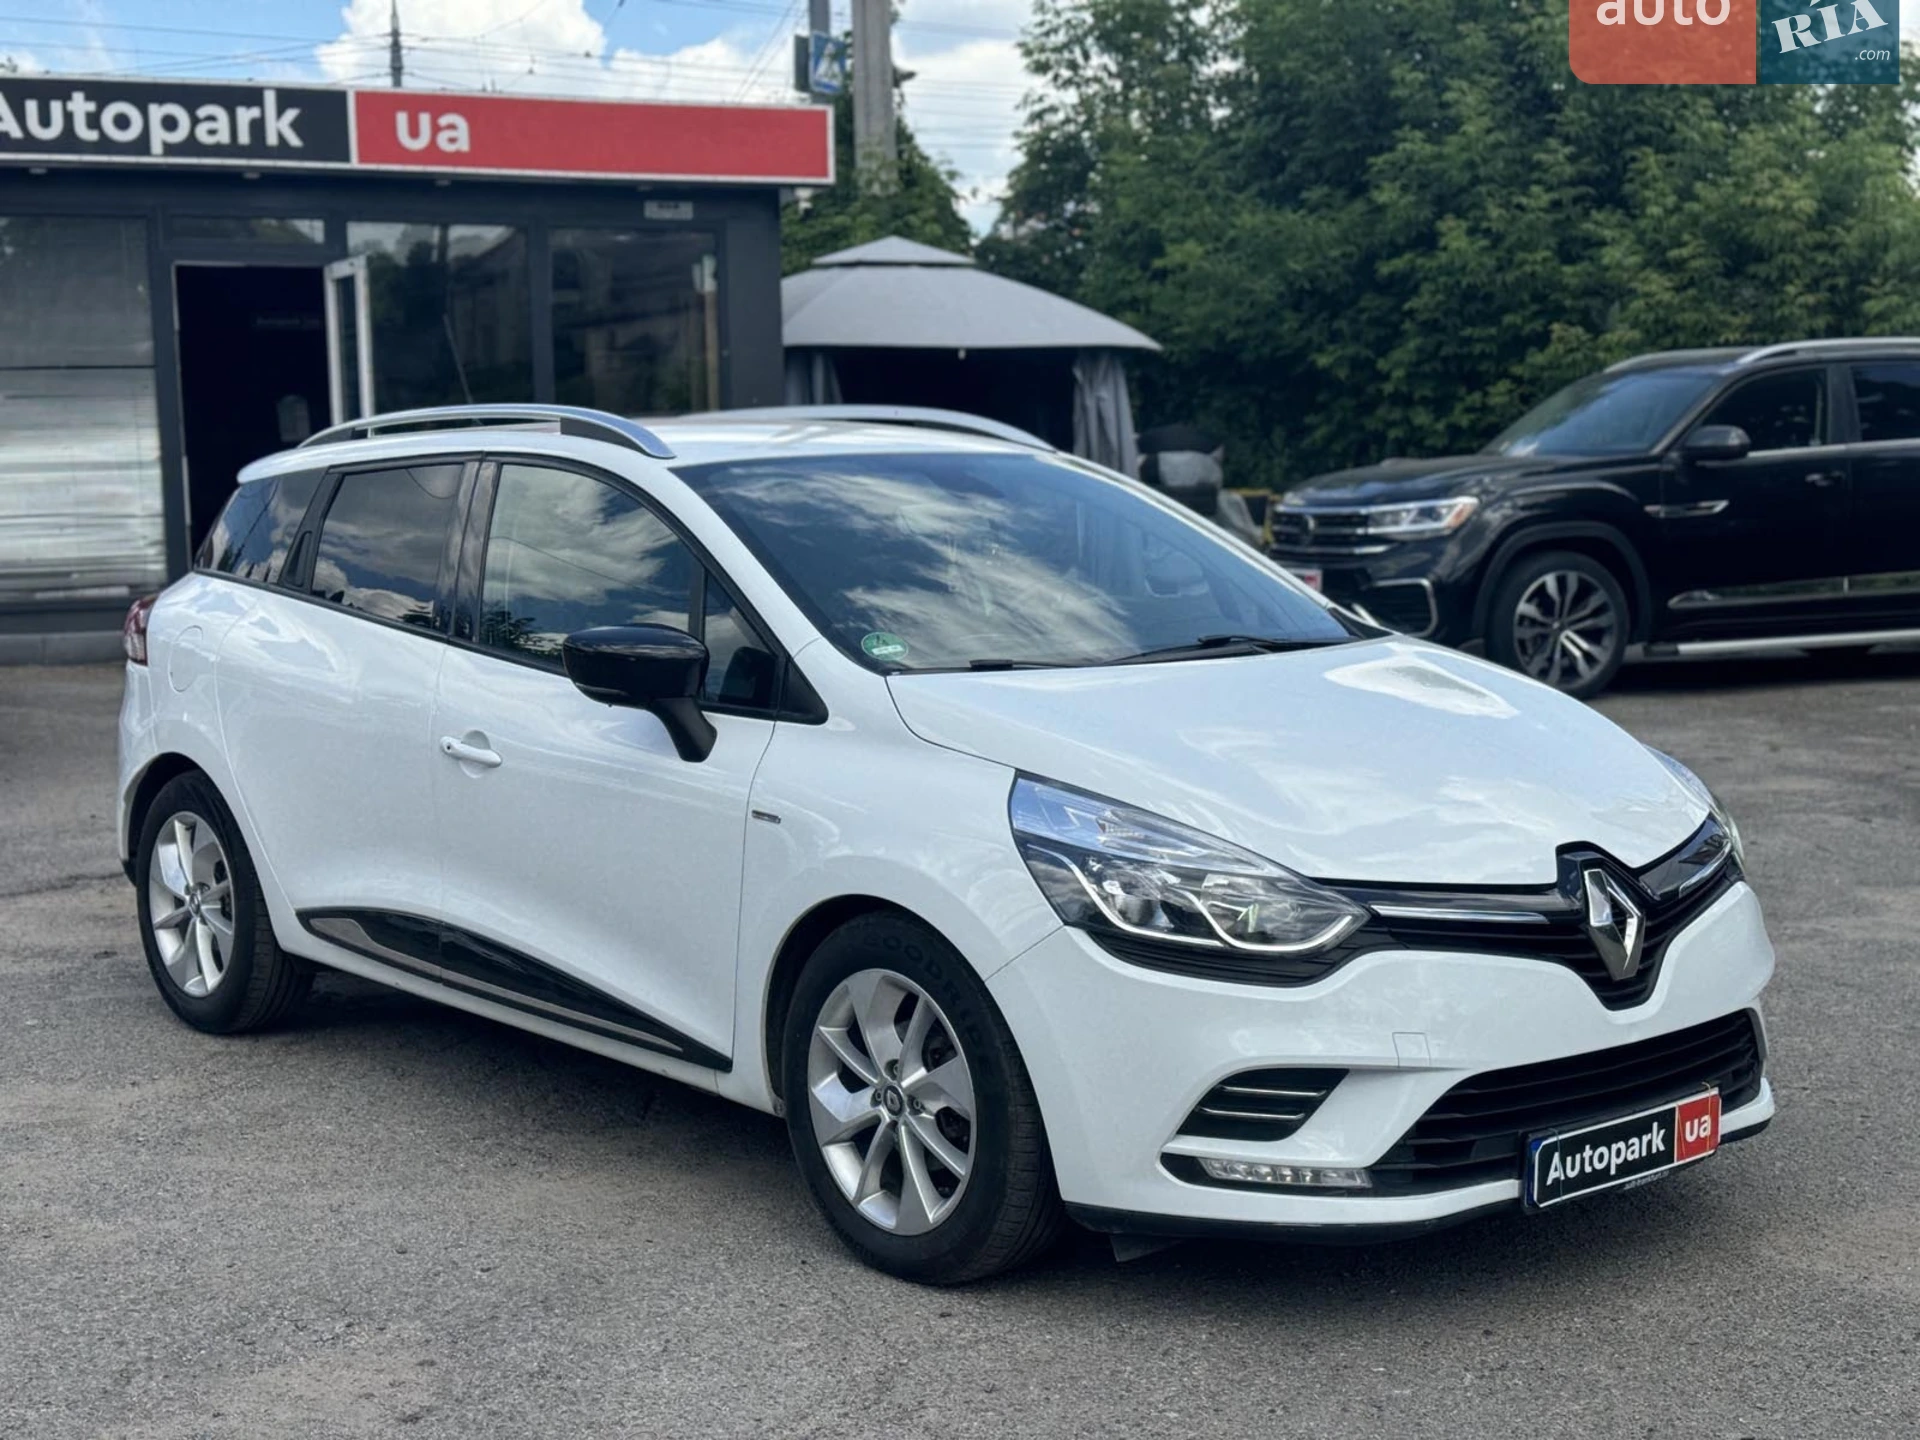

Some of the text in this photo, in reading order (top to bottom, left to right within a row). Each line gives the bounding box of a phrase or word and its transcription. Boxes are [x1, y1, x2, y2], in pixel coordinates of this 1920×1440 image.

[396, 109, 471, 153] ua
[1546, 1121, 1667, 1186] Autopark
[1685, 1113, 1712, 1144] ua
